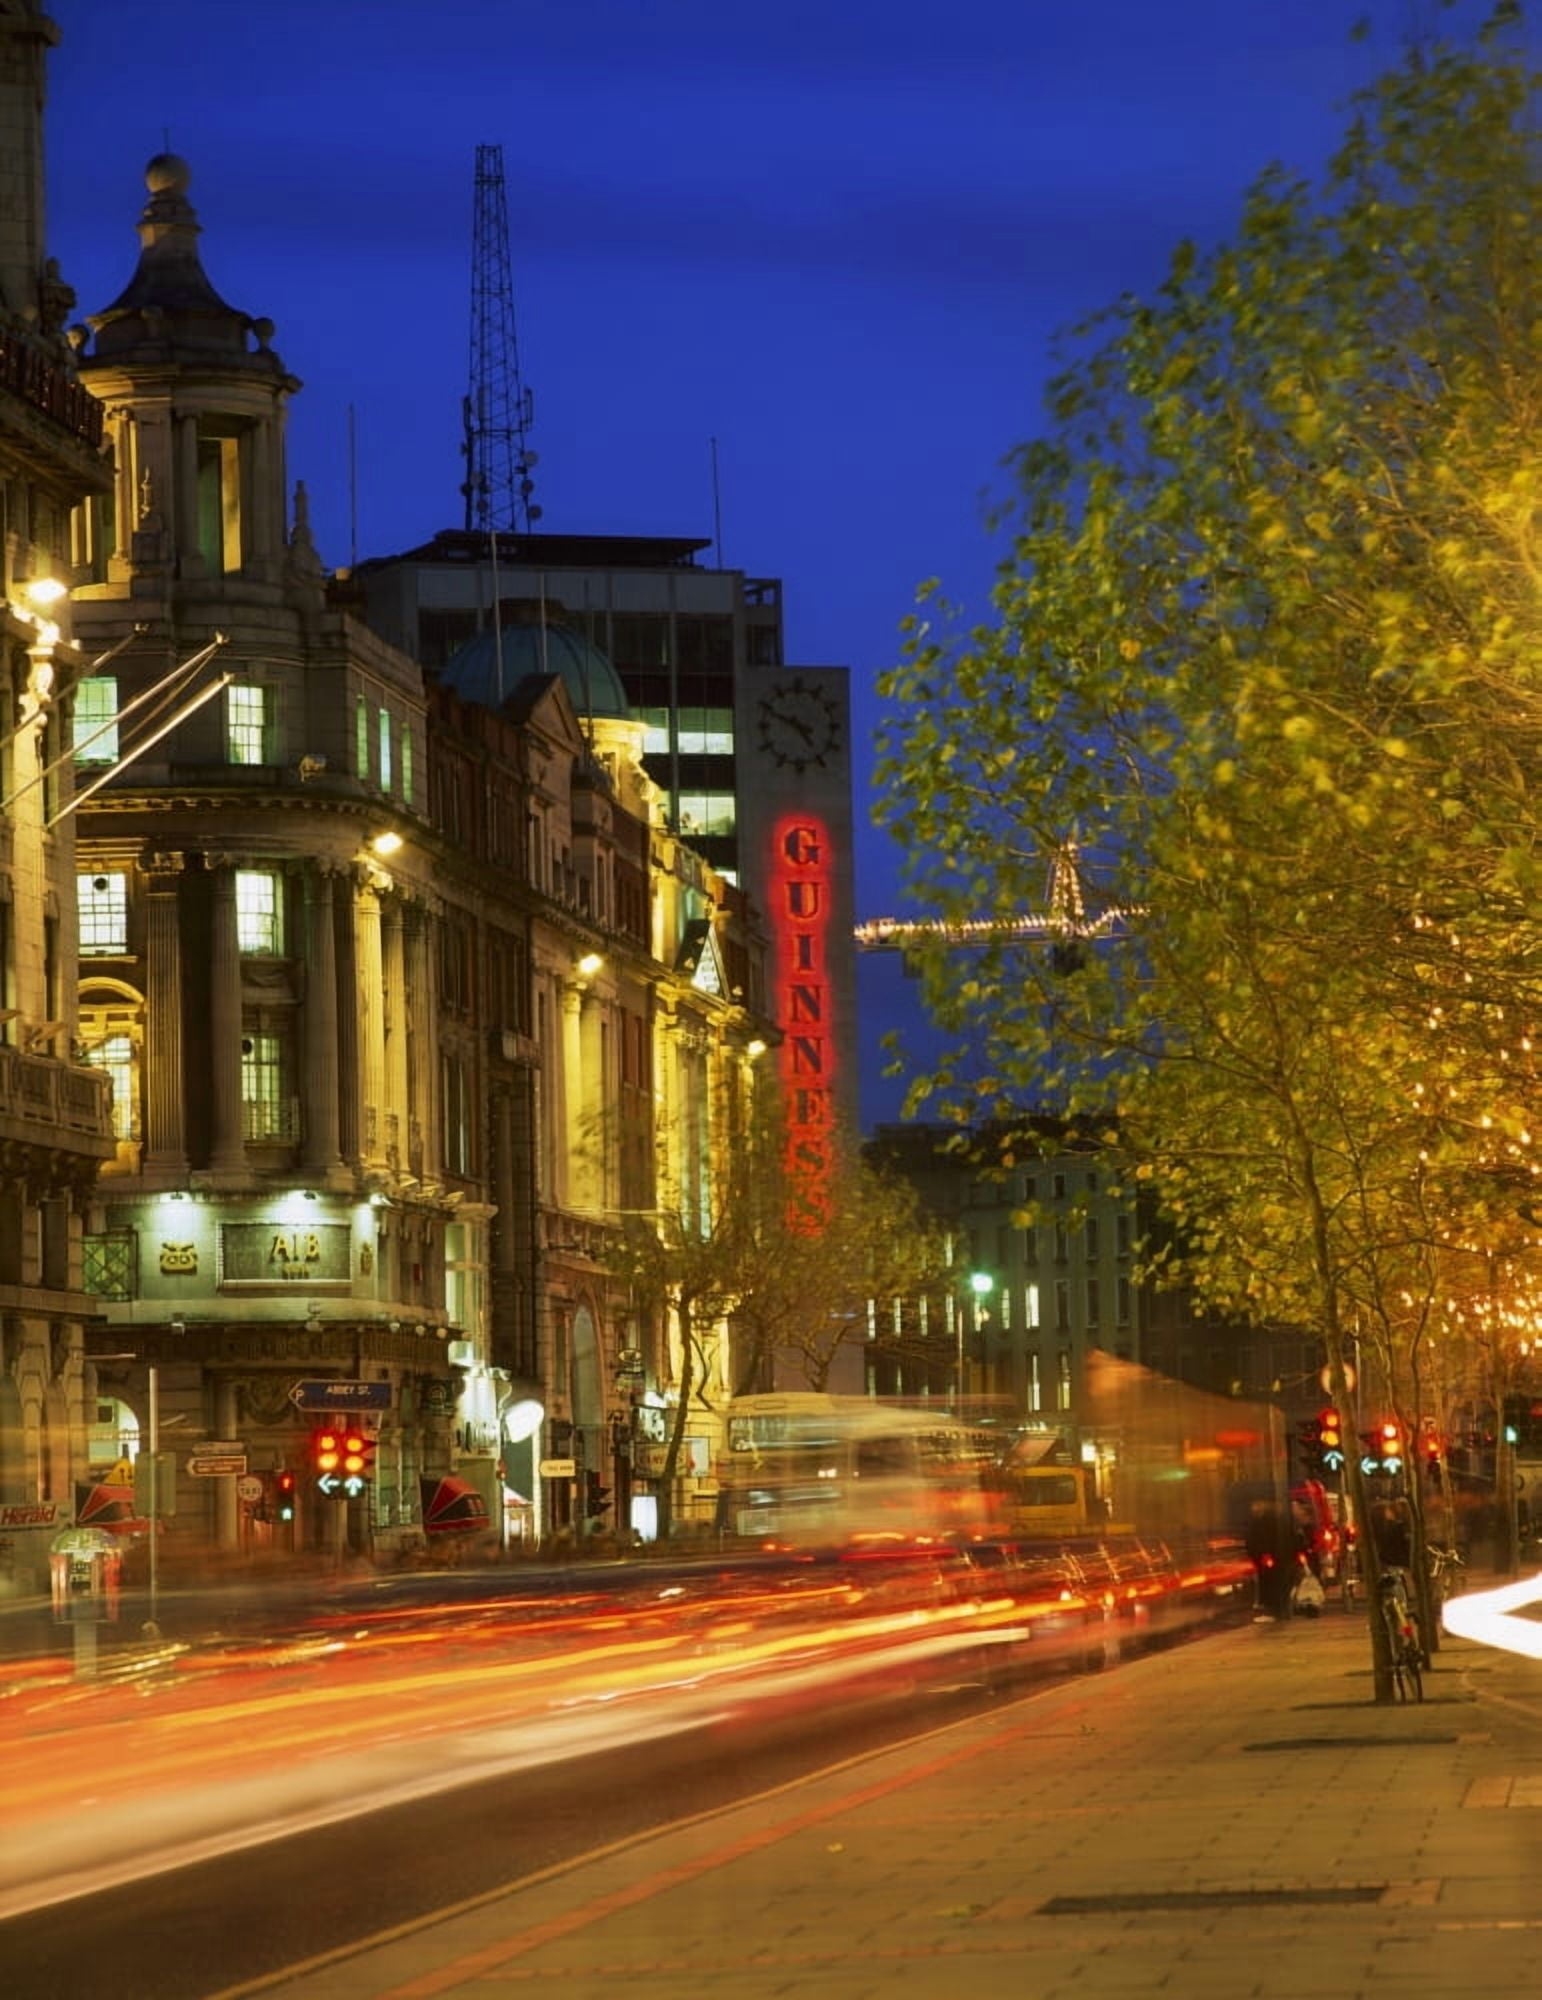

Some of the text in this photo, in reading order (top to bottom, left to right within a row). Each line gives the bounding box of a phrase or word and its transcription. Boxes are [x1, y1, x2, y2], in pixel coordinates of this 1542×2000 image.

[784, 826, 829, 1235] GUINNESS
[268, 1232, 320, 1263] AIB
[1, 1505, 56, 1524] Herald
